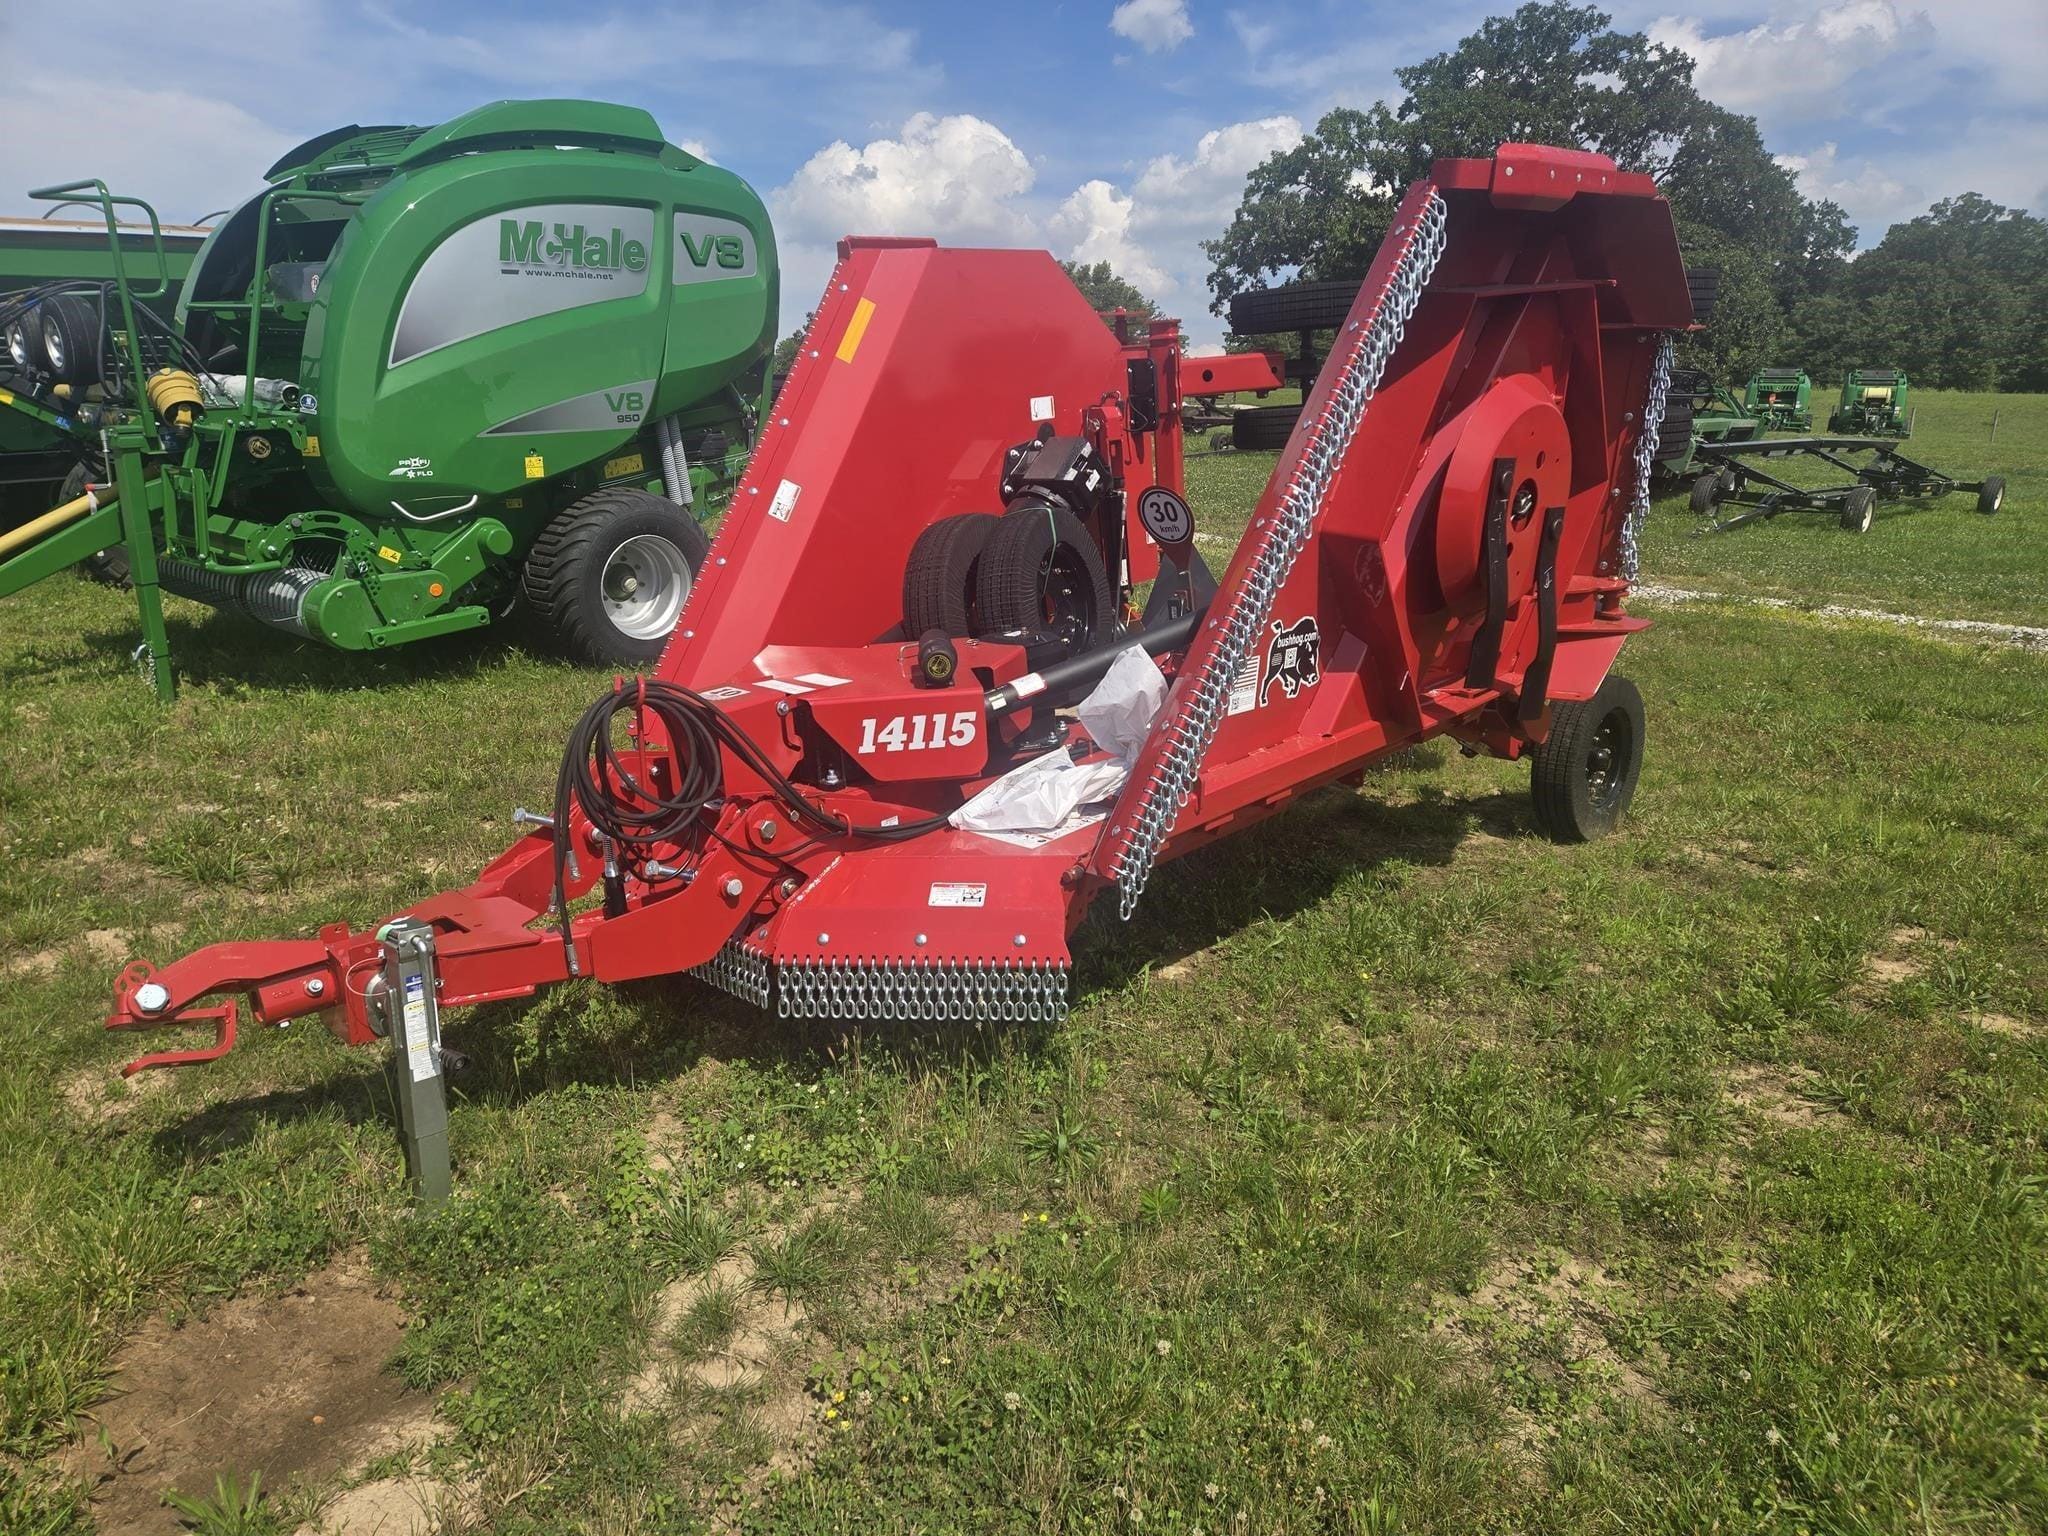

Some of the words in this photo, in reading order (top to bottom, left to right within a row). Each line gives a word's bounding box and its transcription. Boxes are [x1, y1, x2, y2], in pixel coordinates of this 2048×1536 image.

[499, 219, 648, 272] McHale
[680, 232, 745, 269] V8
[524, 268, 614, 281] www.mchale.net
[604, 392, 644, 413] V8
[616, 414, 641, 424] 950
[1149, 501, 1178, 523] 30
[1159, 524, 1180, 533] km/h
[1277, 632, 1318, 648] bushhog.com
[858, 711, 977, 754] 14115
